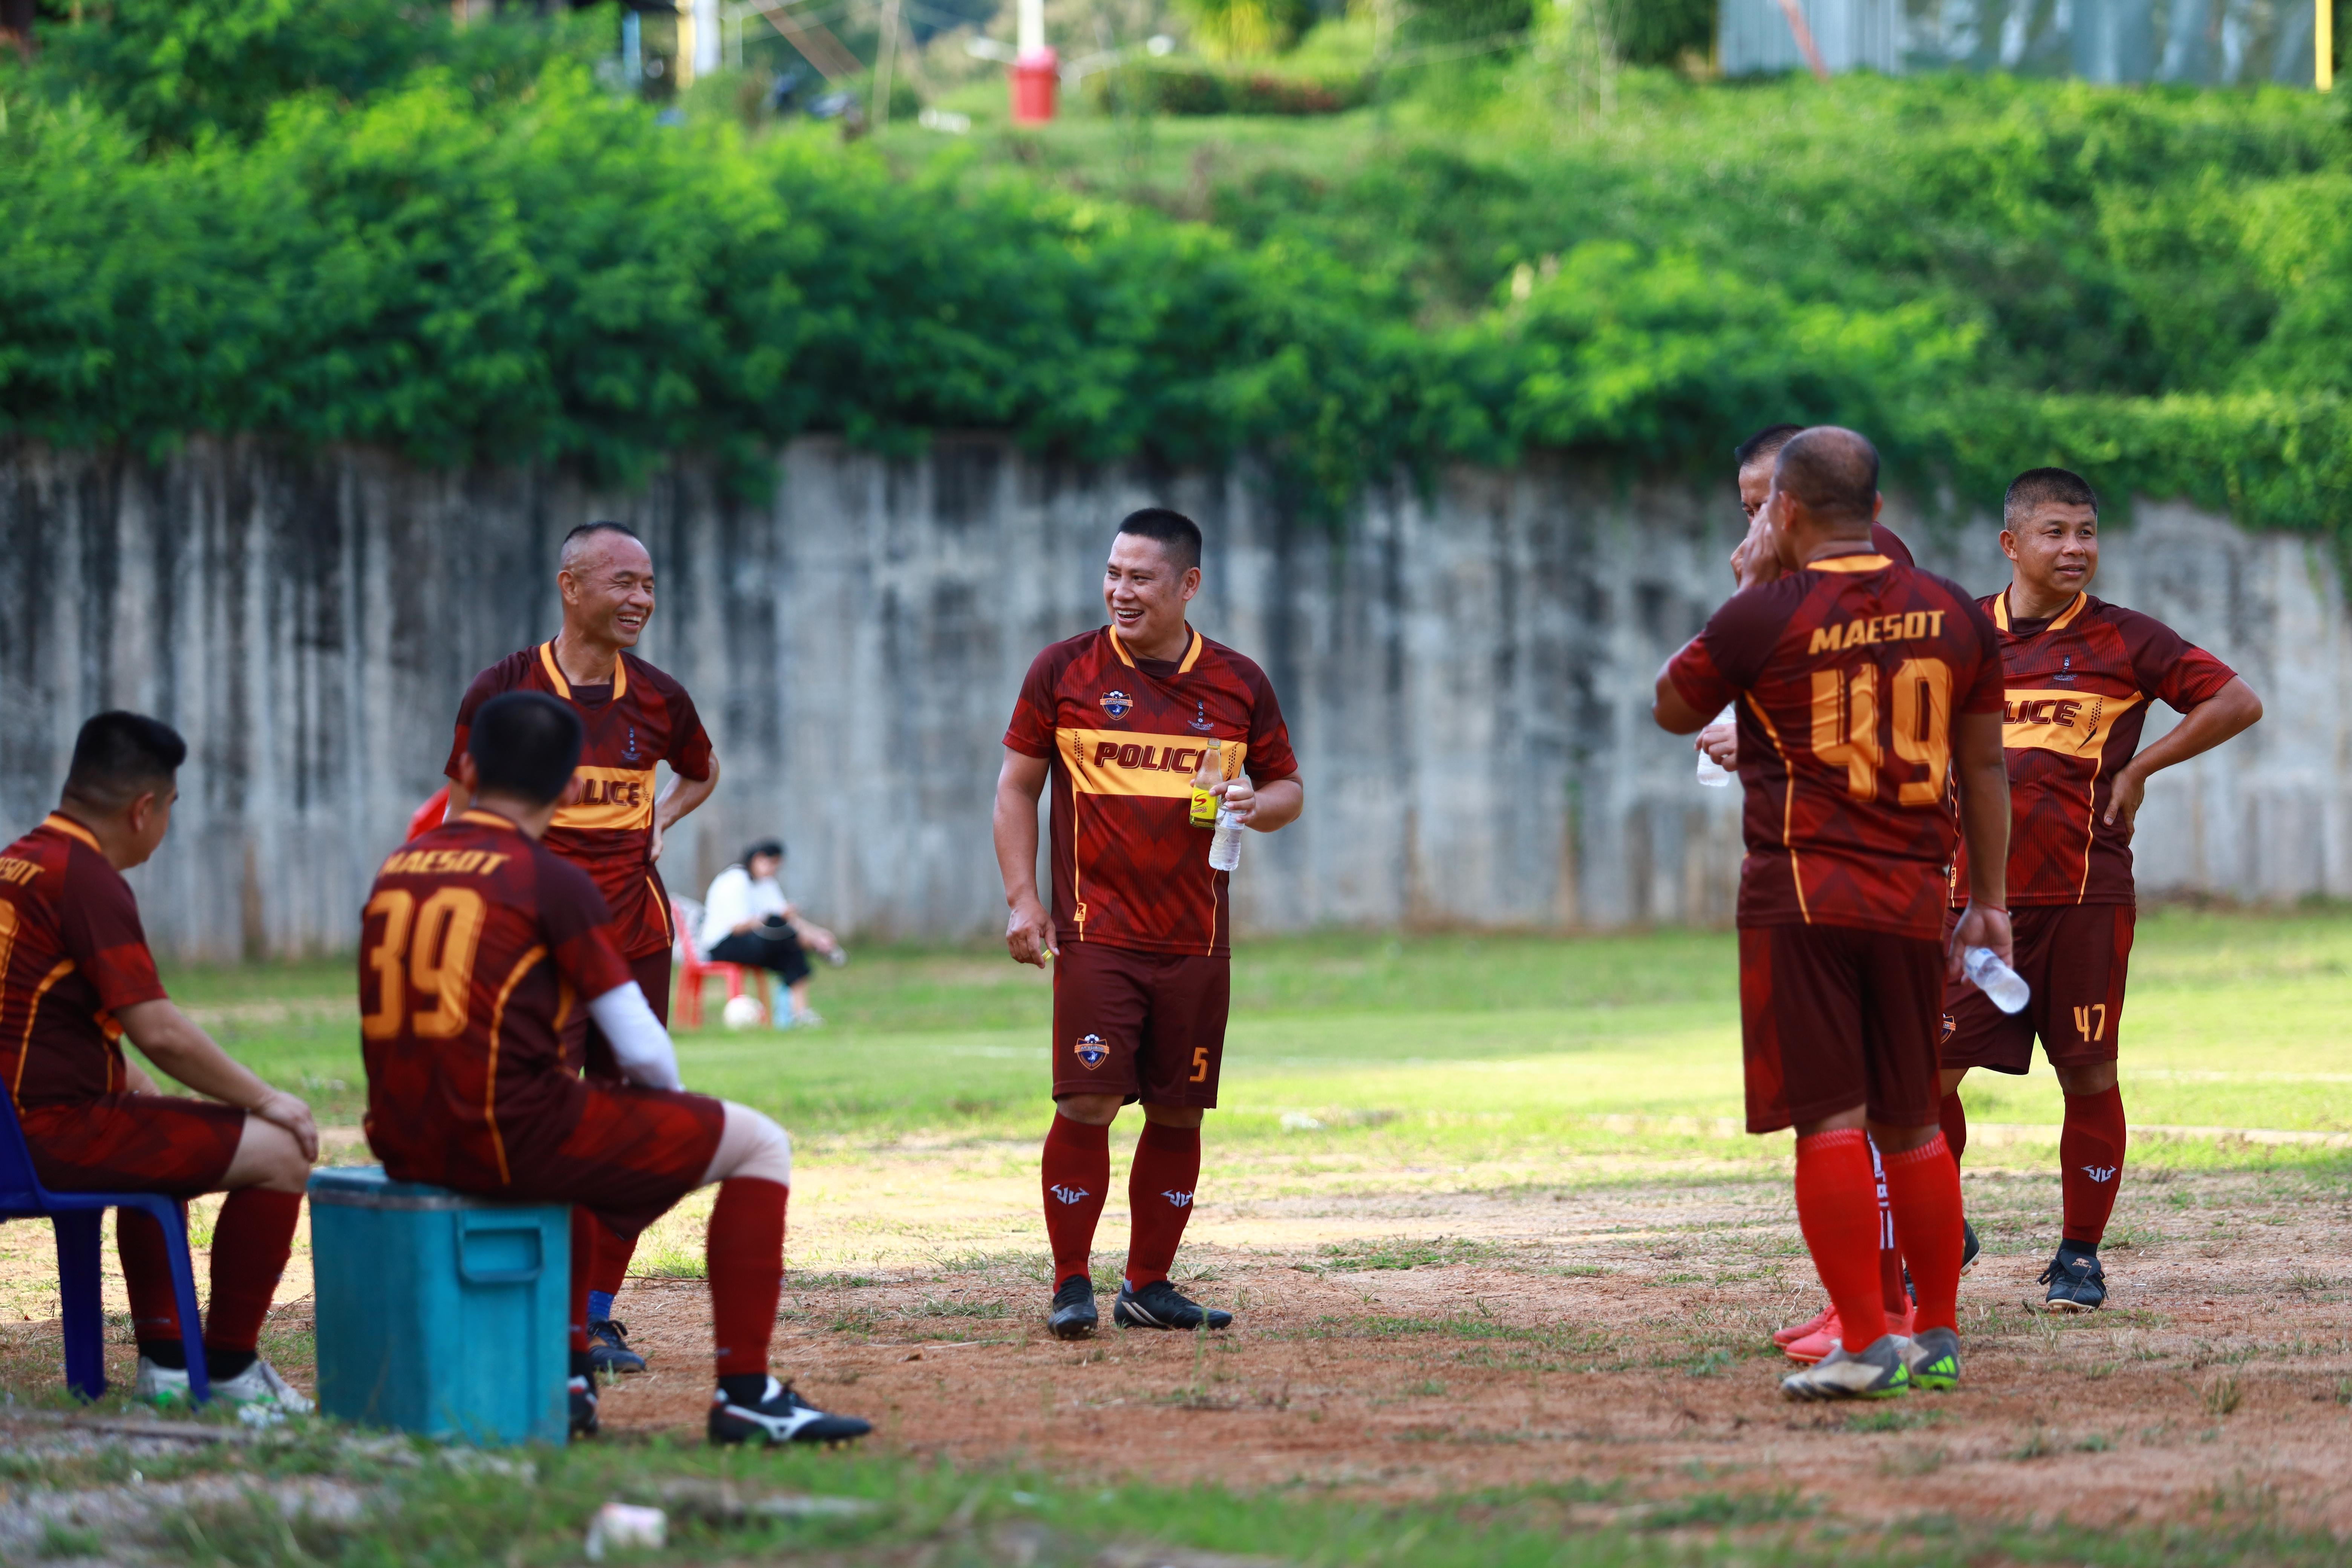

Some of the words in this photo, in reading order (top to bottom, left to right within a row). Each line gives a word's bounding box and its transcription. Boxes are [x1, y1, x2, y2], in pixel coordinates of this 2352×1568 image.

[1808, 610, 1945, 655] MAESOT
[1811, 657, 1953, 806] 49
[571, 778, 640, 808] LICE
[378, 850, 510, 876] MAESOT
[363, 887, 487, 1040] 39
[2073, 1004, 2105, 1042] 47
[1190, 1047, 1209, 1083] 5
